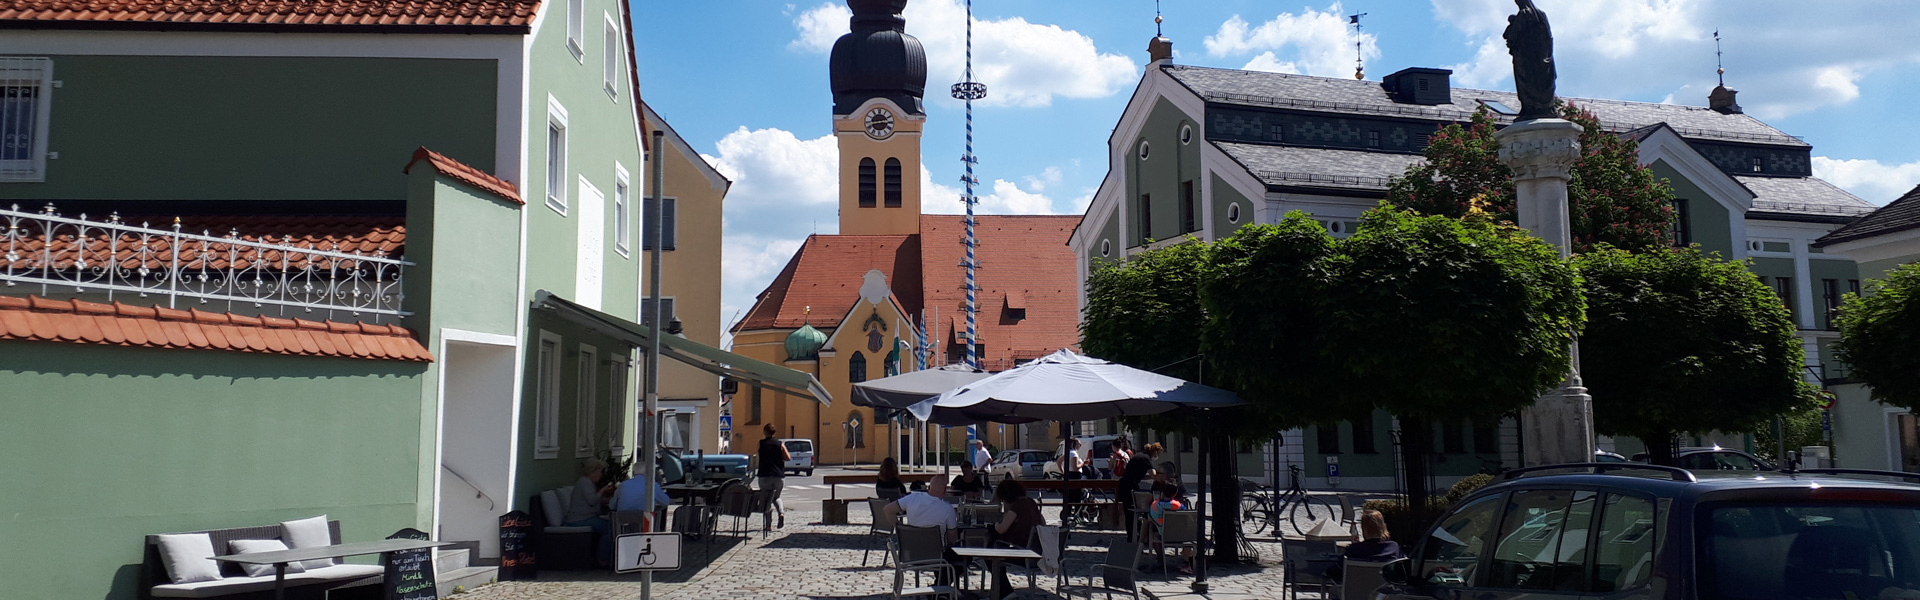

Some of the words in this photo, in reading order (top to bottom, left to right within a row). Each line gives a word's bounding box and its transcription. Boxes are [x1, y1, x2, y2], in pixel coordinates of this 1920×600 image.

[1330, 465, 1336, 476] P
[413, 553, 430, 562] Tisch
[399, 562, 420, 572] erlaubt
[396, 580, 432, 593] Nasenschutz
